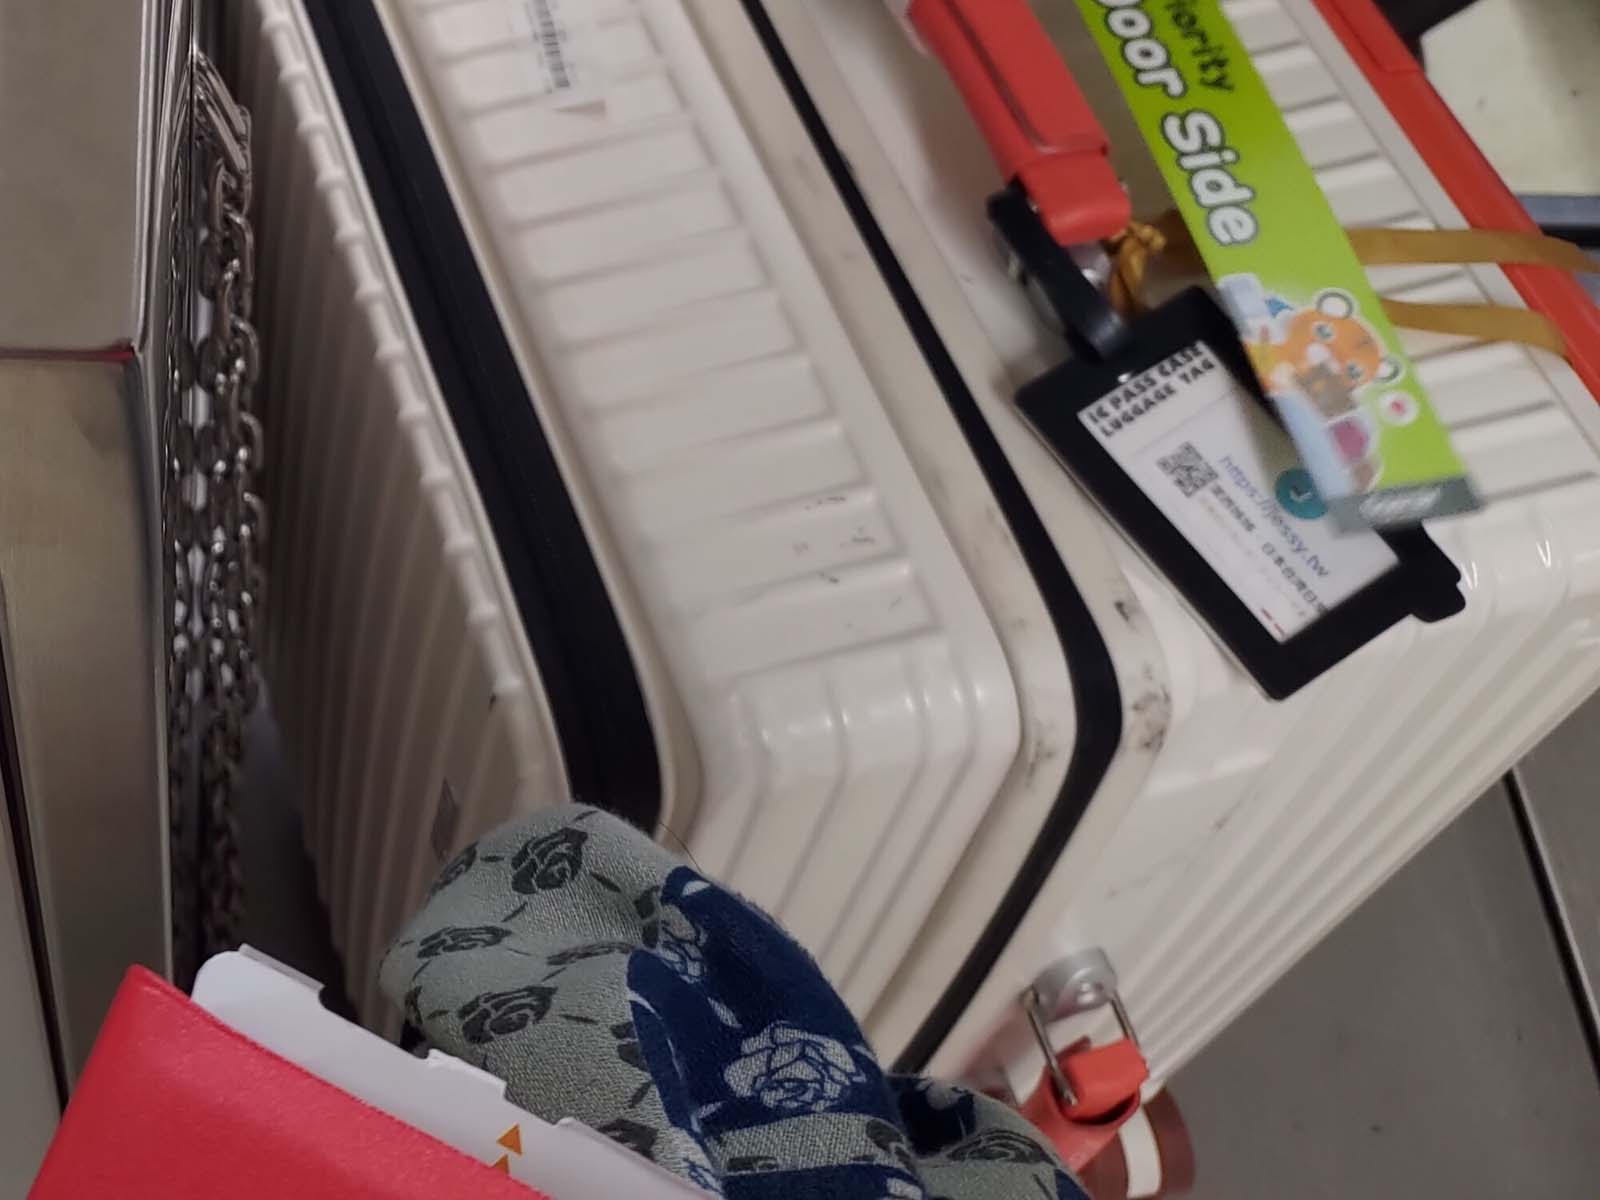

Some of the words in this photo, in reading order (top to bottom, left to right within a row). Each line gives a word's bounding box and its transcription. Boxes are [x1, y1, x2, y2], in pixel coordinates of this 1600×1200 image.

[1161, 110, 1259, 246] Side
[1101, 382, 1177, 438] LUGGAGE
[1178, 358, 1215, 384] TAG
[1110, 373, 1157, 411] PASS
